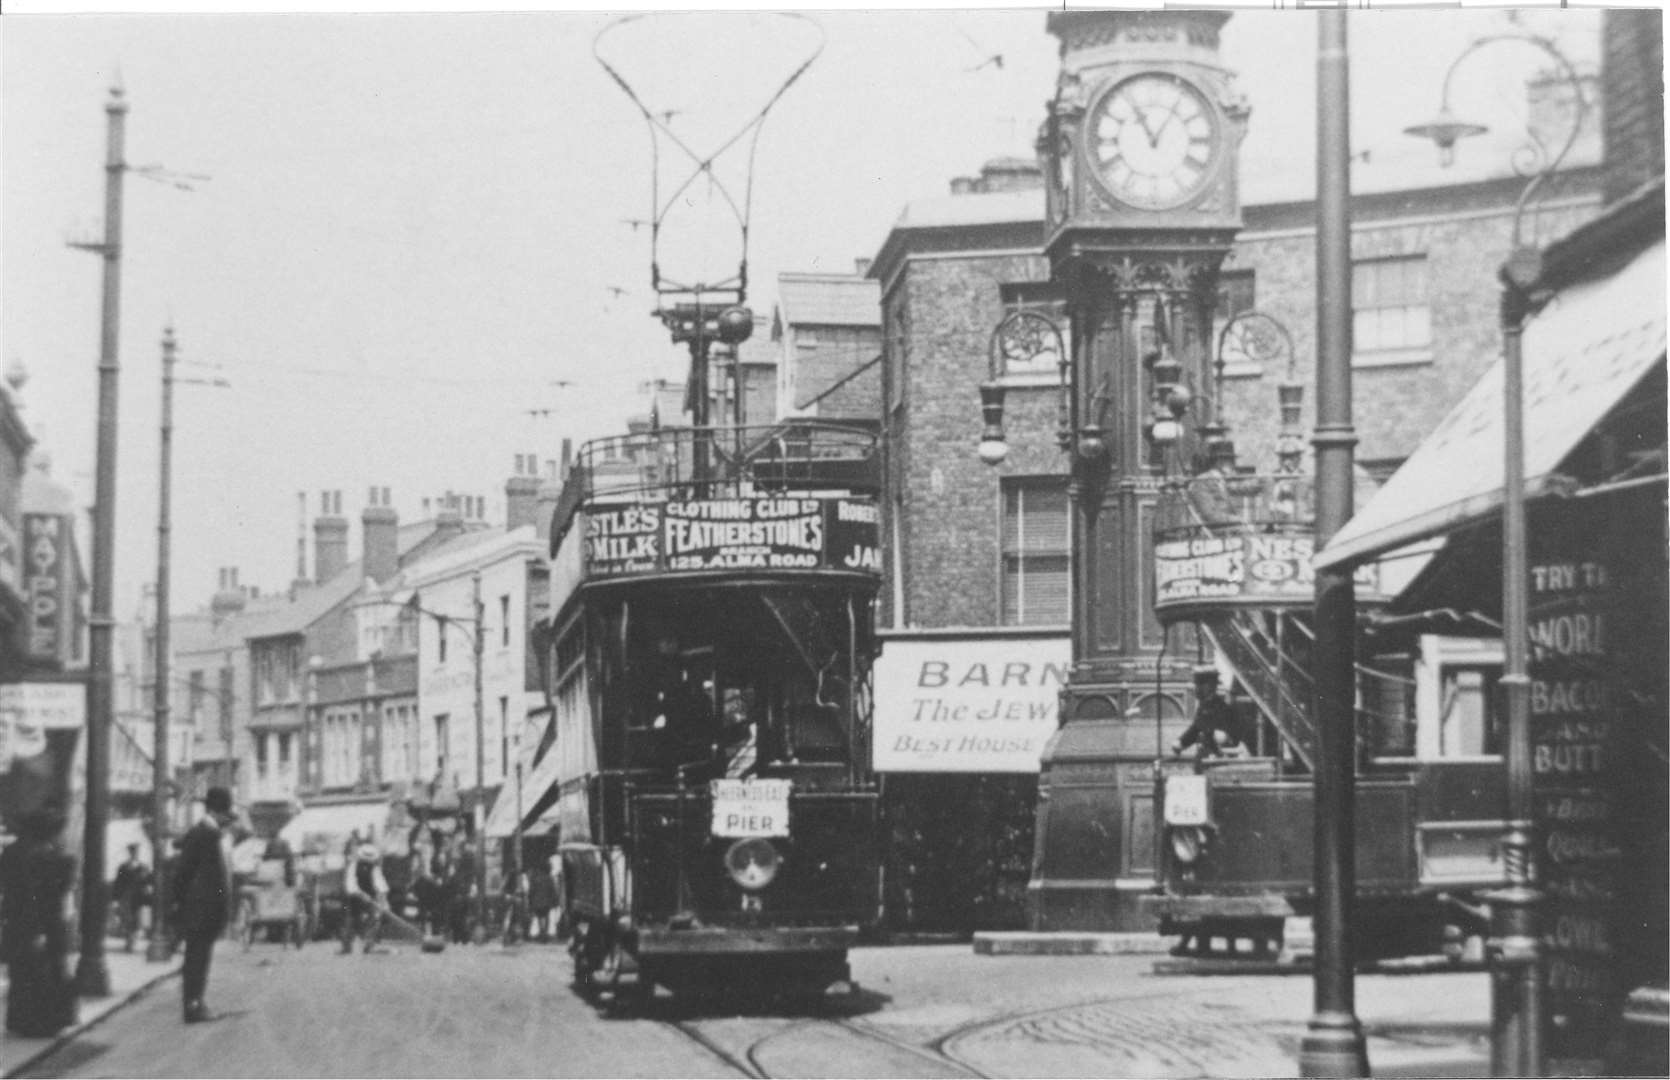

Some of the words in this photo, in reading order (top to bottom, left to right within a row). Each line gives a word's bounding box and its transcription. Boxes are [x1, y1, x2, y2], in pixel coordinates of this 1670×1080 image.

[666, 500, 752, 519] CLOTHING
[756, 500, 799, 518] CLUB
[593, 535, 659, 561] MILK
[710, 553, 767, 568] ALMA
[769, 554, 818, 567] ROAD
[1532, 565, 1575, 591] TRY
[912, 699, 969, 722] The
[957, 735, 1033, 752] HOUSE
[727, 814, 773, 831] PIER
